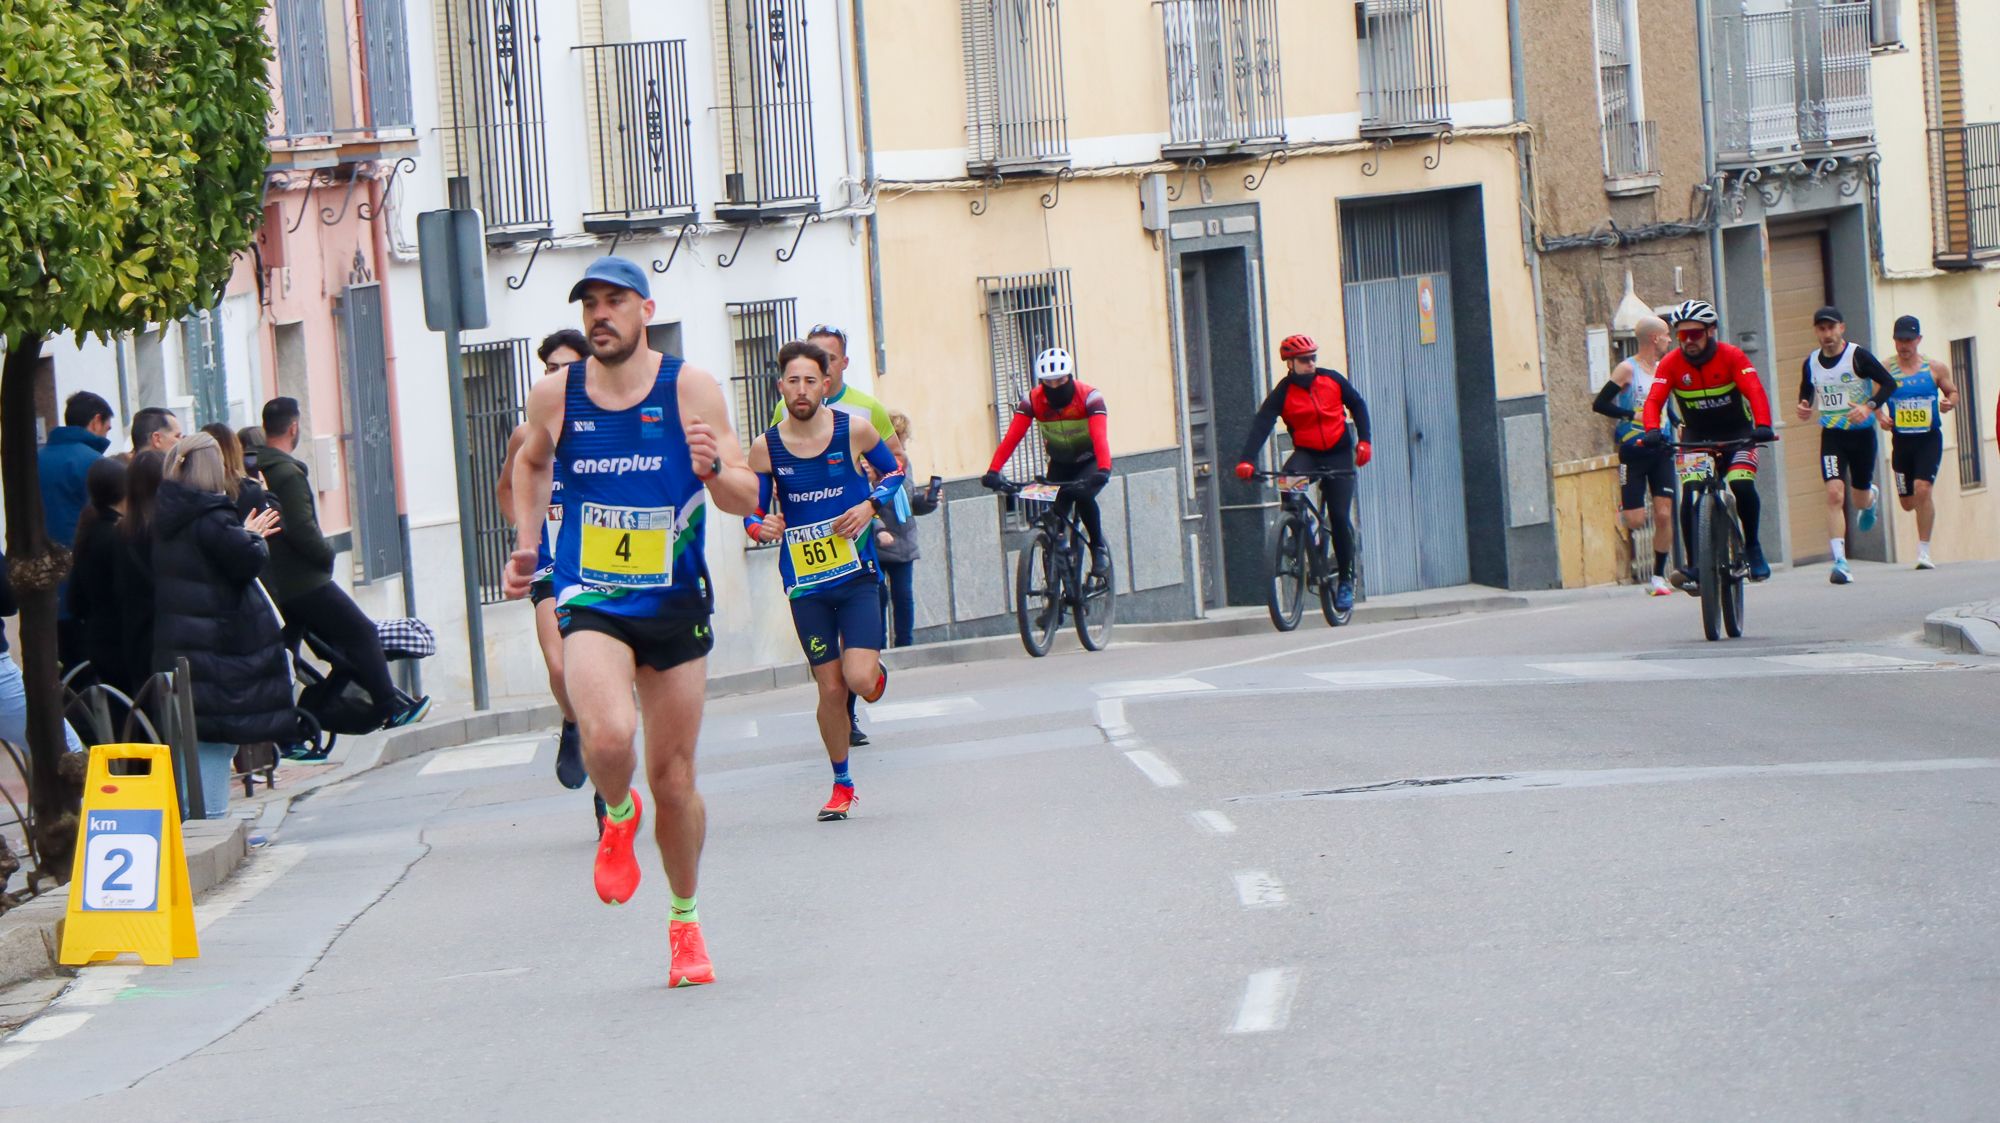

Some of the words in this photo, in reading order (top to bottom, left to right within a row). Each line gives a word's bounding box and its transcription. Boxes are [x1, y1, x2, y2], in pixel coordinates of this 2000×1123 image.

[1900, 409, 1927, 423] 1359
[572, 454, 663, 476] enerplus
[788, 486, 844, 503] enerplus
[615, 532, 631, 562] 4
[802, 538, 838, 566] 561
[90, 816, 117, 831] km
[101, 847, 134, 891] 2
